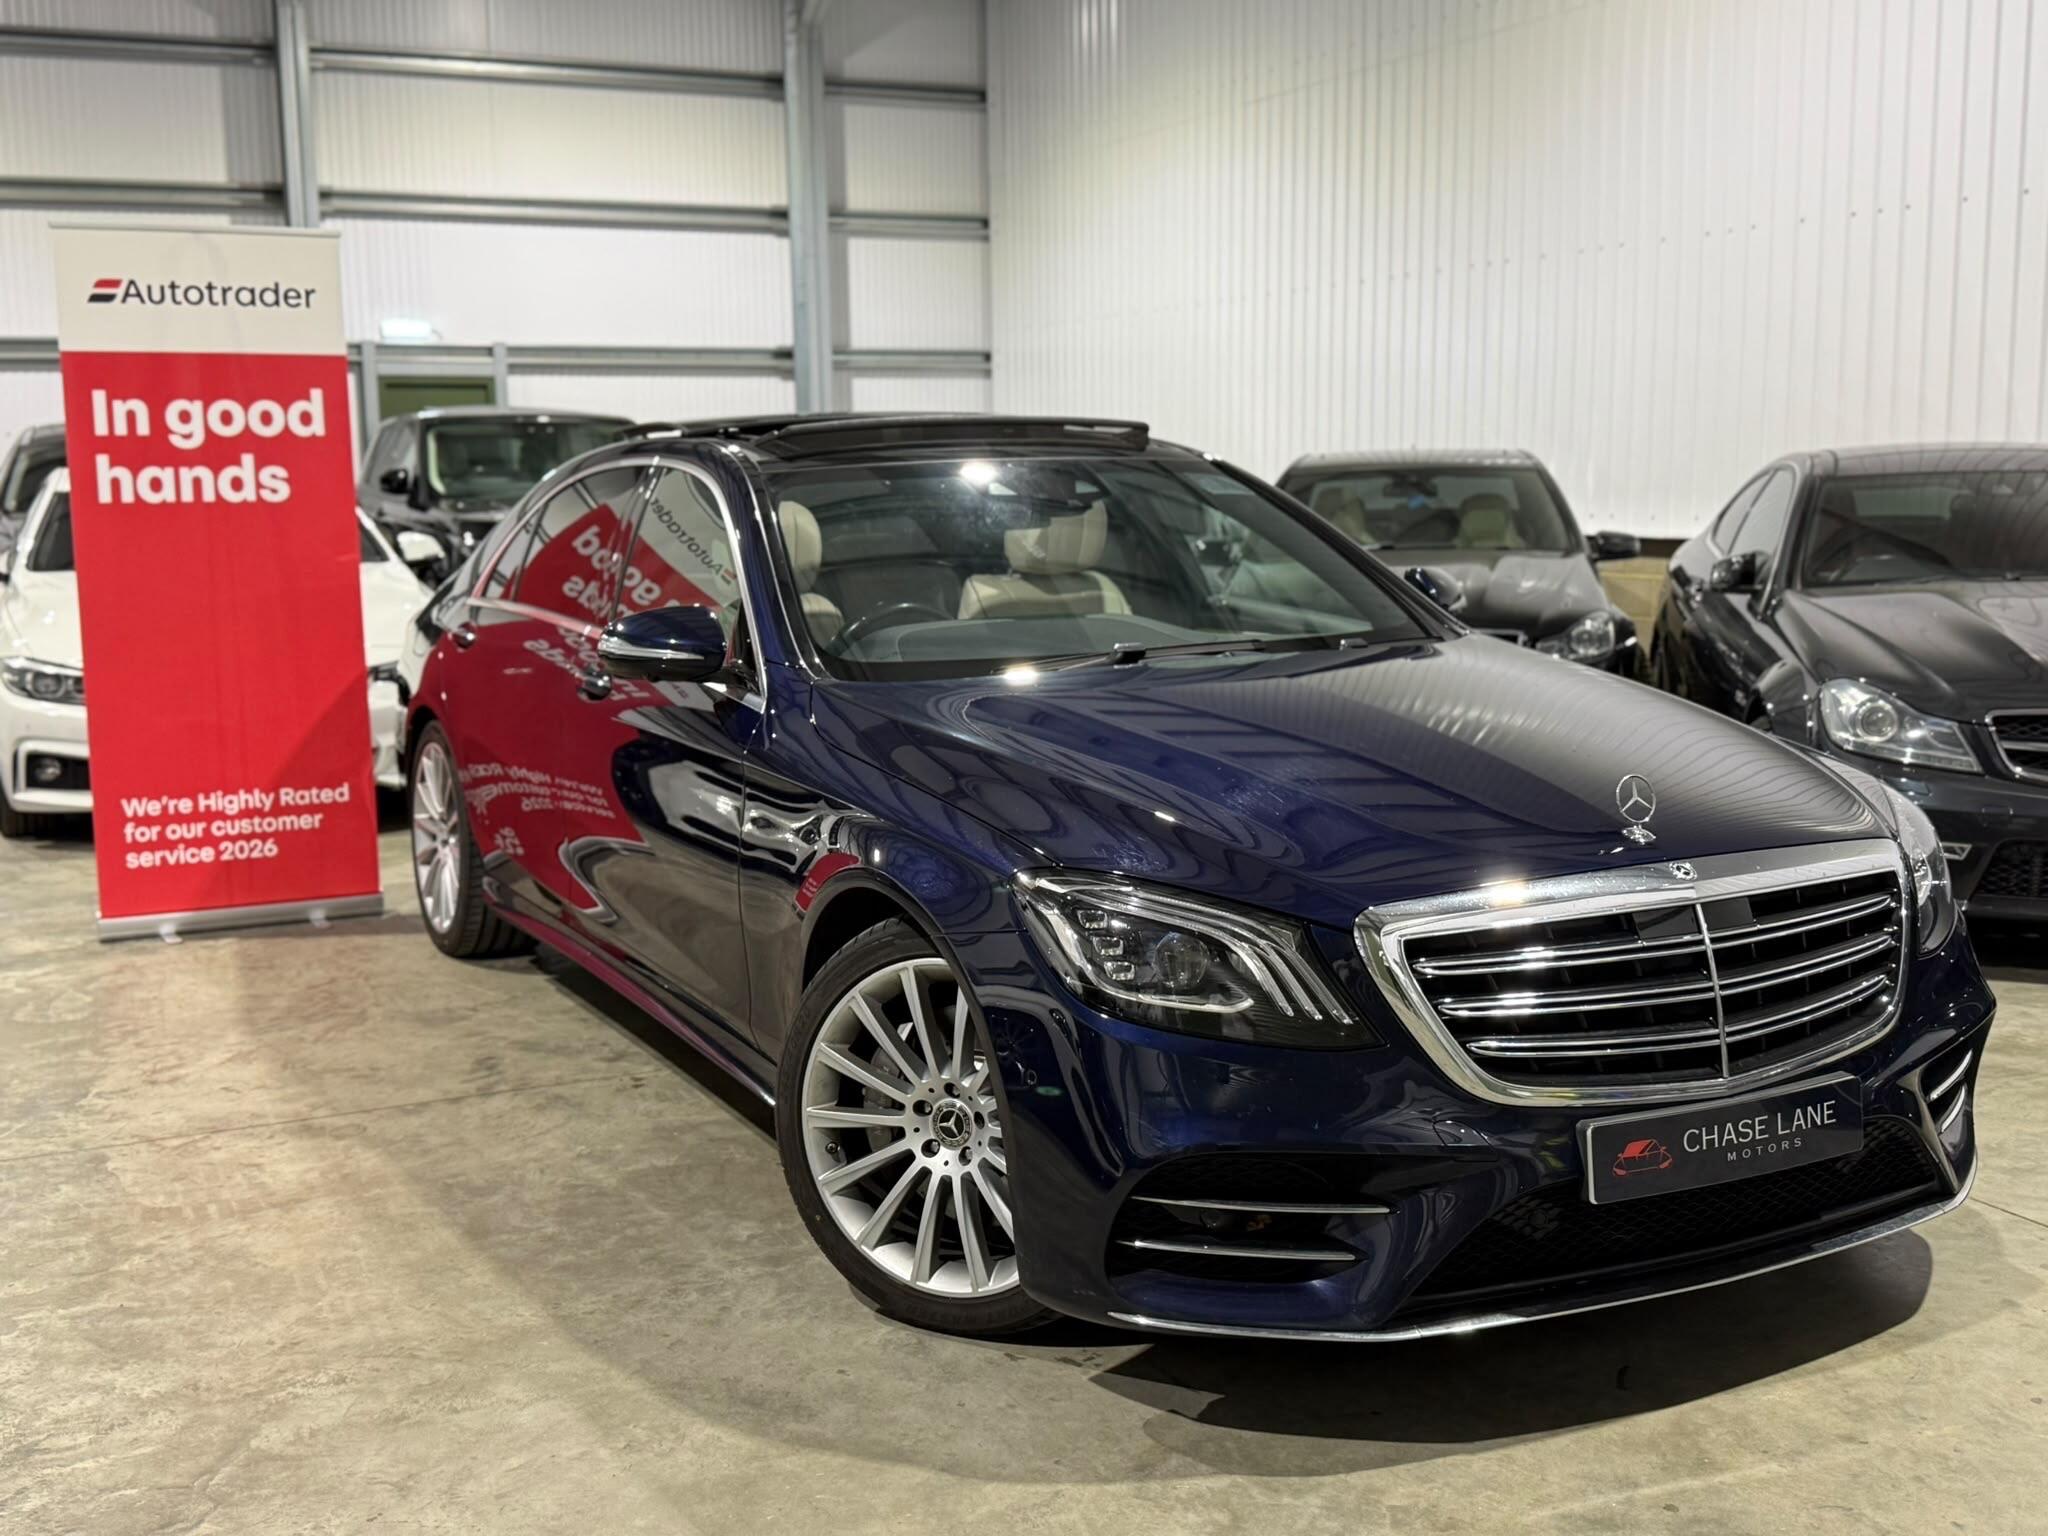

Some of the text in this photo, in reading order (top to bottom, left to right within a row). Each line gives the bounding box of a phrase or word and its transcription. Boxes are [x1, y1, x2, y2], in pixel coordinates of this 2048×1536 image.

[120, 279, 316, 309] Autotrader
[91, 388, 326, 450] In good
[95, 452, 291, 504] hands
[198, 788, 274, 816] Highly
[279, 782, 350, 807] Rated
[124, 813, 323, 843] for our customer
[126, 838, 278, 869] service 2026
[1683, 1100, 1837, 1153] CHASE LANE
[1727, 1137, 1802, 1162] MOTORS
